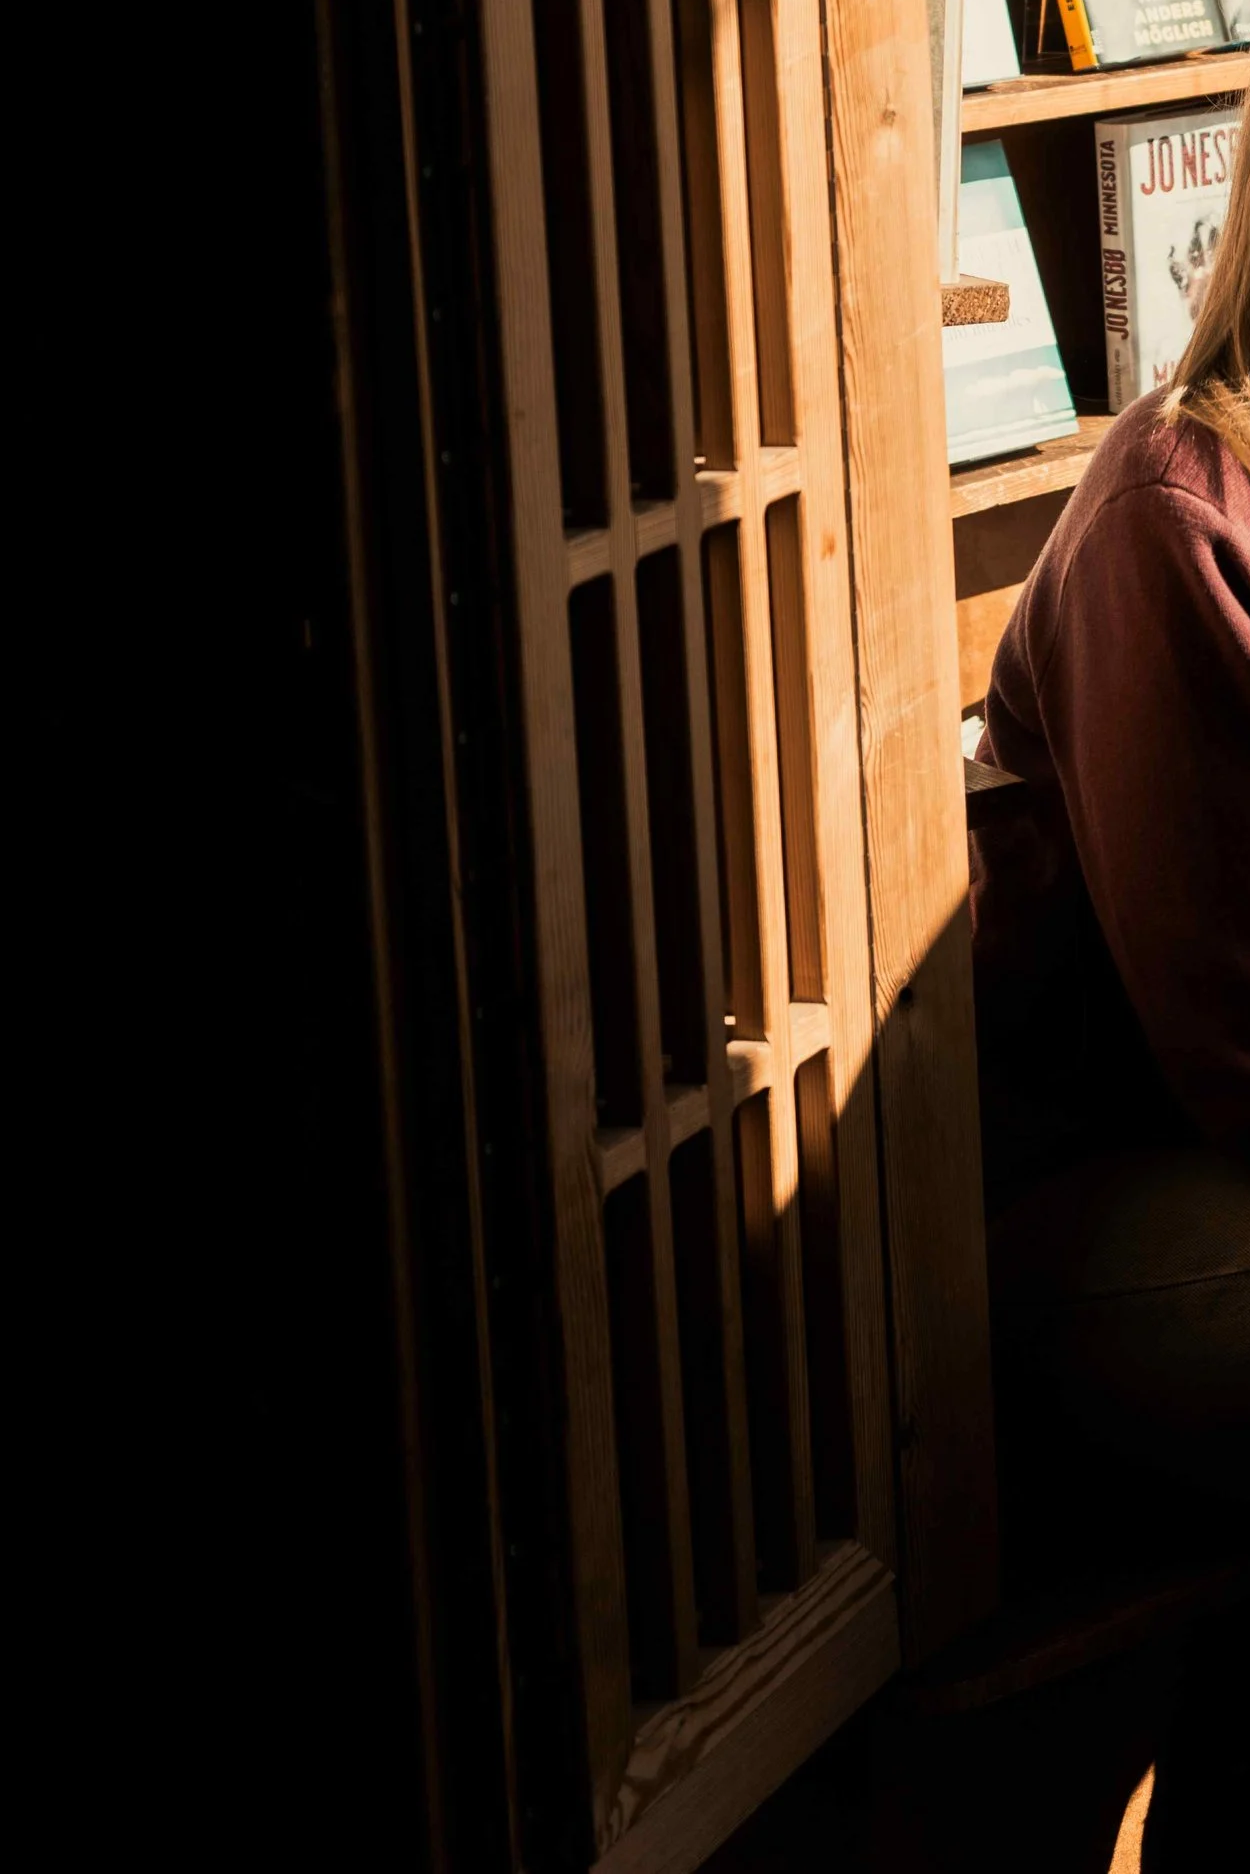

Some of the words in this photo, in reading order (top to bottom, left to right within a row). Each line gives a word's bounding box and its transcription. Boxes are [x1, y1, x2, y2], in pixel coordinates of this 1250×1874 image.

[1134, 0, 1206, 24] ANDERS
[1134, 19, 1214, 47] MÖGLICH
[1100, 139, 1118, 236] MINNESOTA
[1140, 134, 1174, 196] JO
[1103, 248, 1129, 314] NESBØ
[1106, 313, 1129, 341] JO
